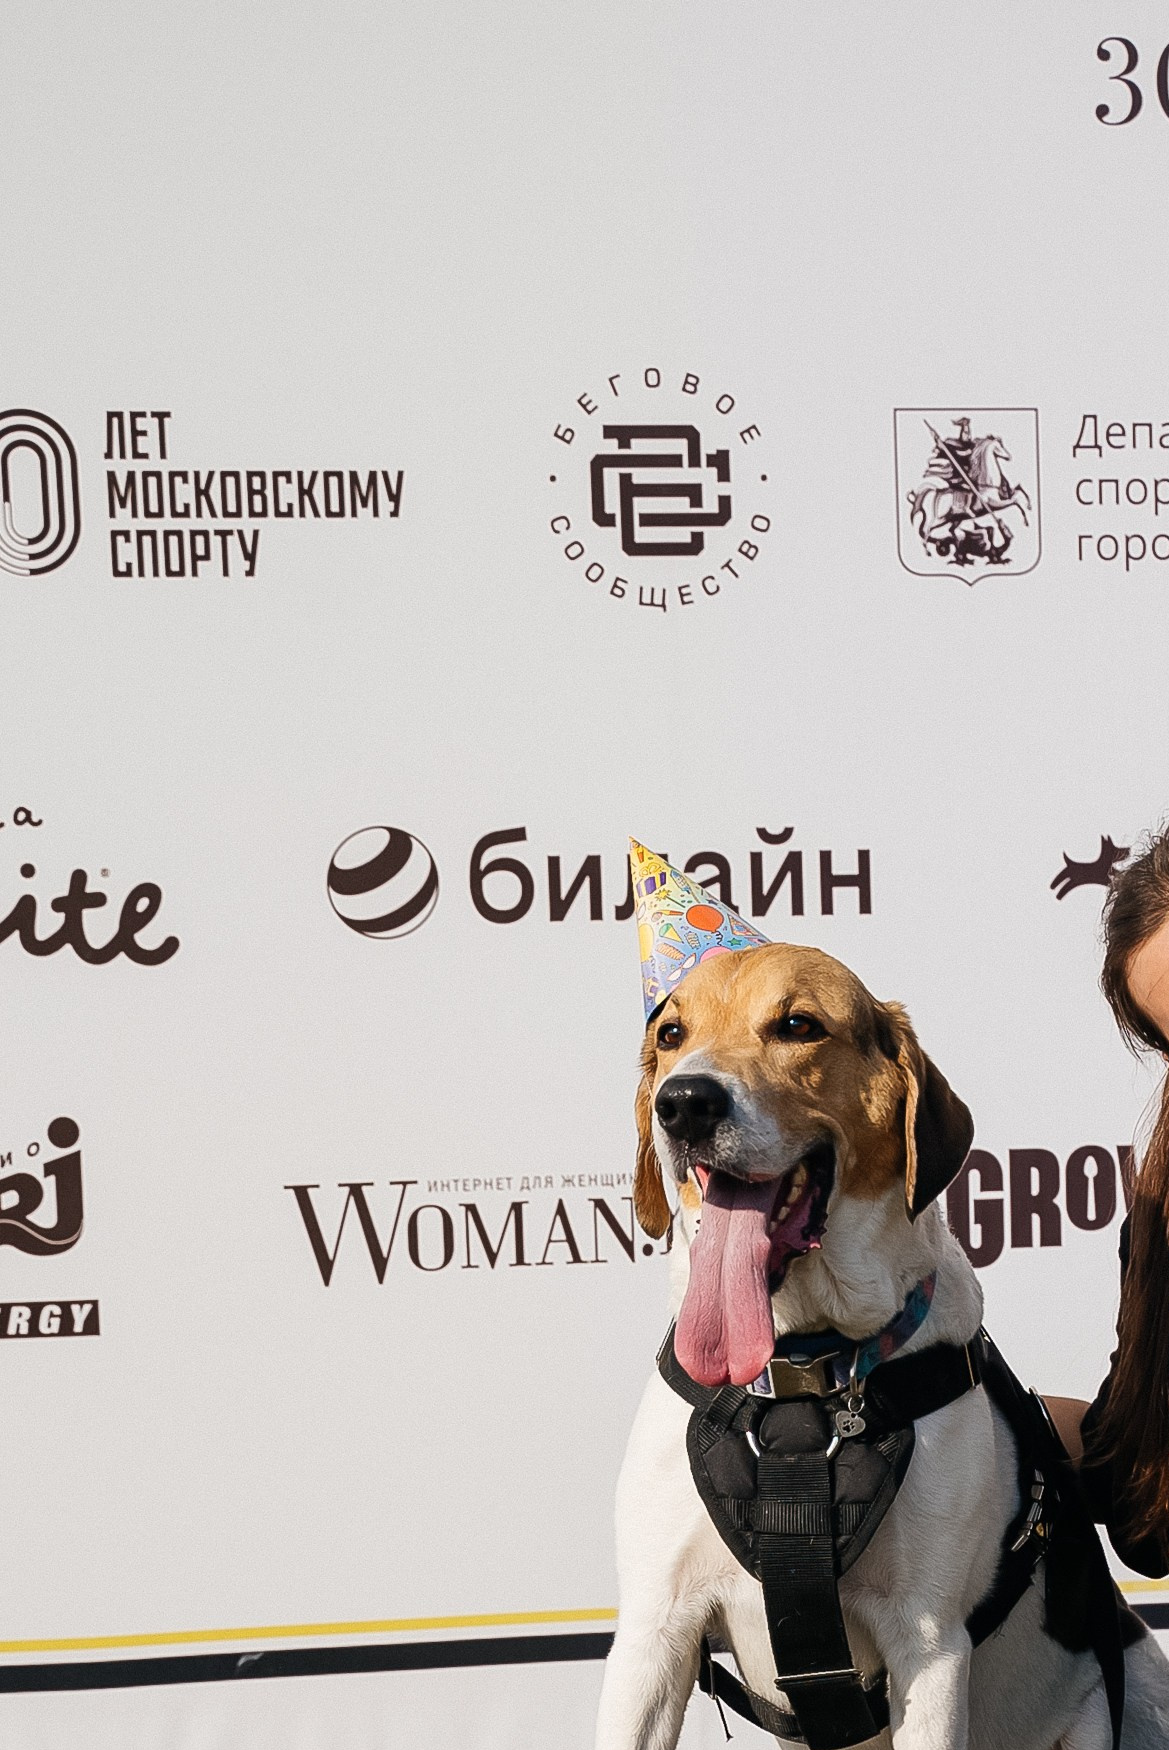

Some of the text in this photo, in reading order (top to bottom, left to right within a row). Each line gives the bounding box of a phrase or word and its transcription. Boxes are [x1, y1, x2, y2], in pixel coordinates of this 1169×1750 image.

[553, 366, 762, 446] БЕГОВОЕ
[104, 411, 172, 461] ЛЕТ
[107, 471, 405, 520] МОСКОВСКОМУ
[111, 530, 261, 579] СПОРТУ
[549, 513, 771, 613] СООБЩЕСТВО
[0, 864, 181, 968] ite
[429, 1178, 513, 1194] ИНТЕРНЕТ
[520, 1176, 555, 1193] ДЛЯ
[0, 1302, 93, 1337] RGY
